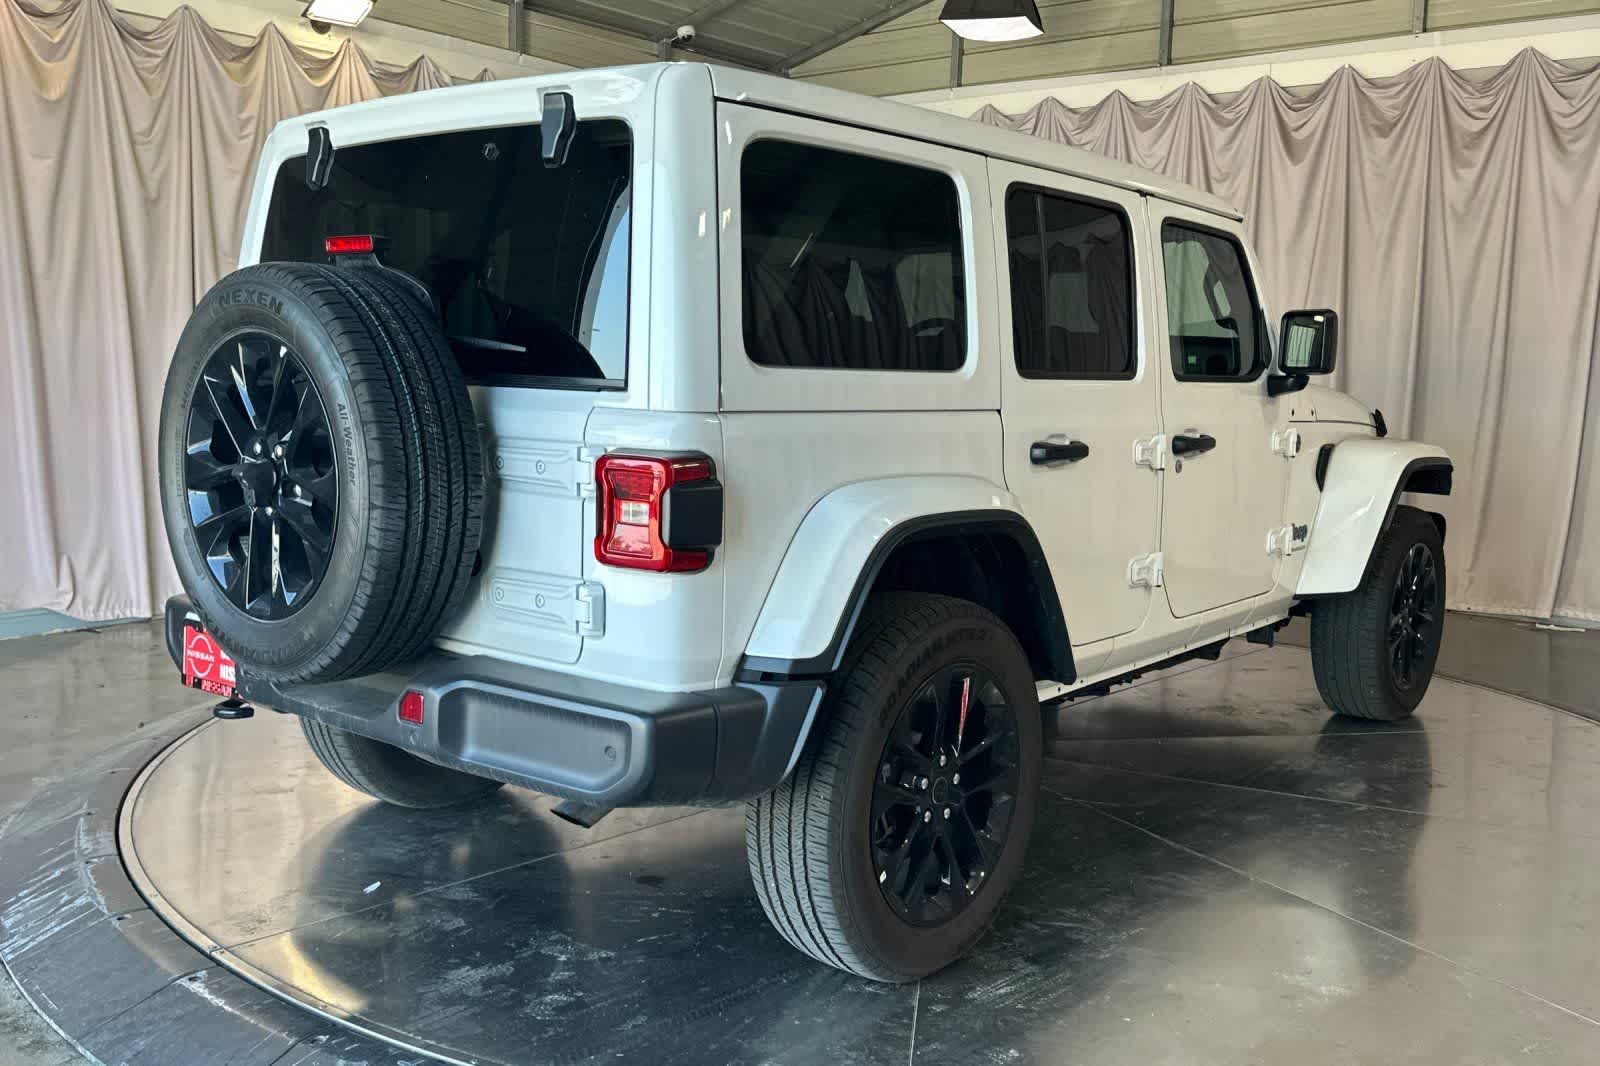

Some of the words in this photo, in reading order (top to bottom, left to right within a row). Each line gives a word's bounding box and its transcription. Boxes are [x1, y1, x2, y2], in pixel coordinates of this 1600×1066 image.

[220, 288, 284, 315] NEXEN
[337, 402, 357, 487] All-Weather
[187, 648, 215, 663] NISSAN
